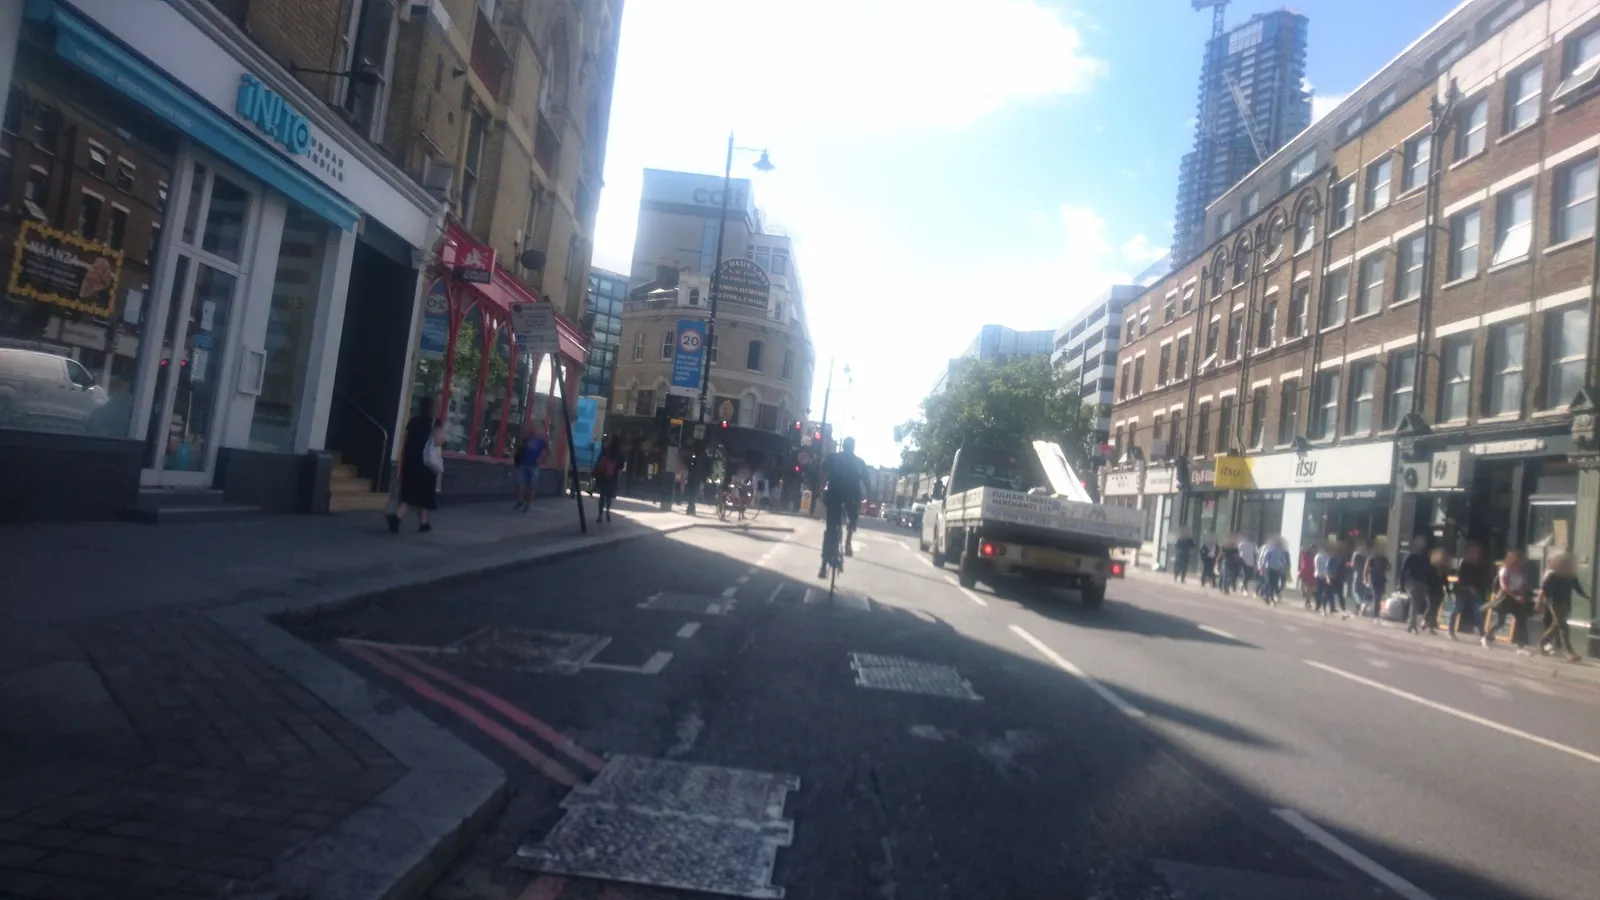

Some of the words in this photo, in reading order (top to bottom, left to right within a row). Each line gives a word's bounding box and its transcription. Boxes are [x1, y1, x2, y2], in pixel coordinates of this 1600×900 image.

[311, 136, 344, 168] URBAN
[307, 149, 344, 182] INDIAN
[682, 335, 699, 347] 20
[1220, 466, 1241, 478] itsu
[1295, 457, 1317, 477] itsu
[992, 490, 1025, 501] FULHAM
